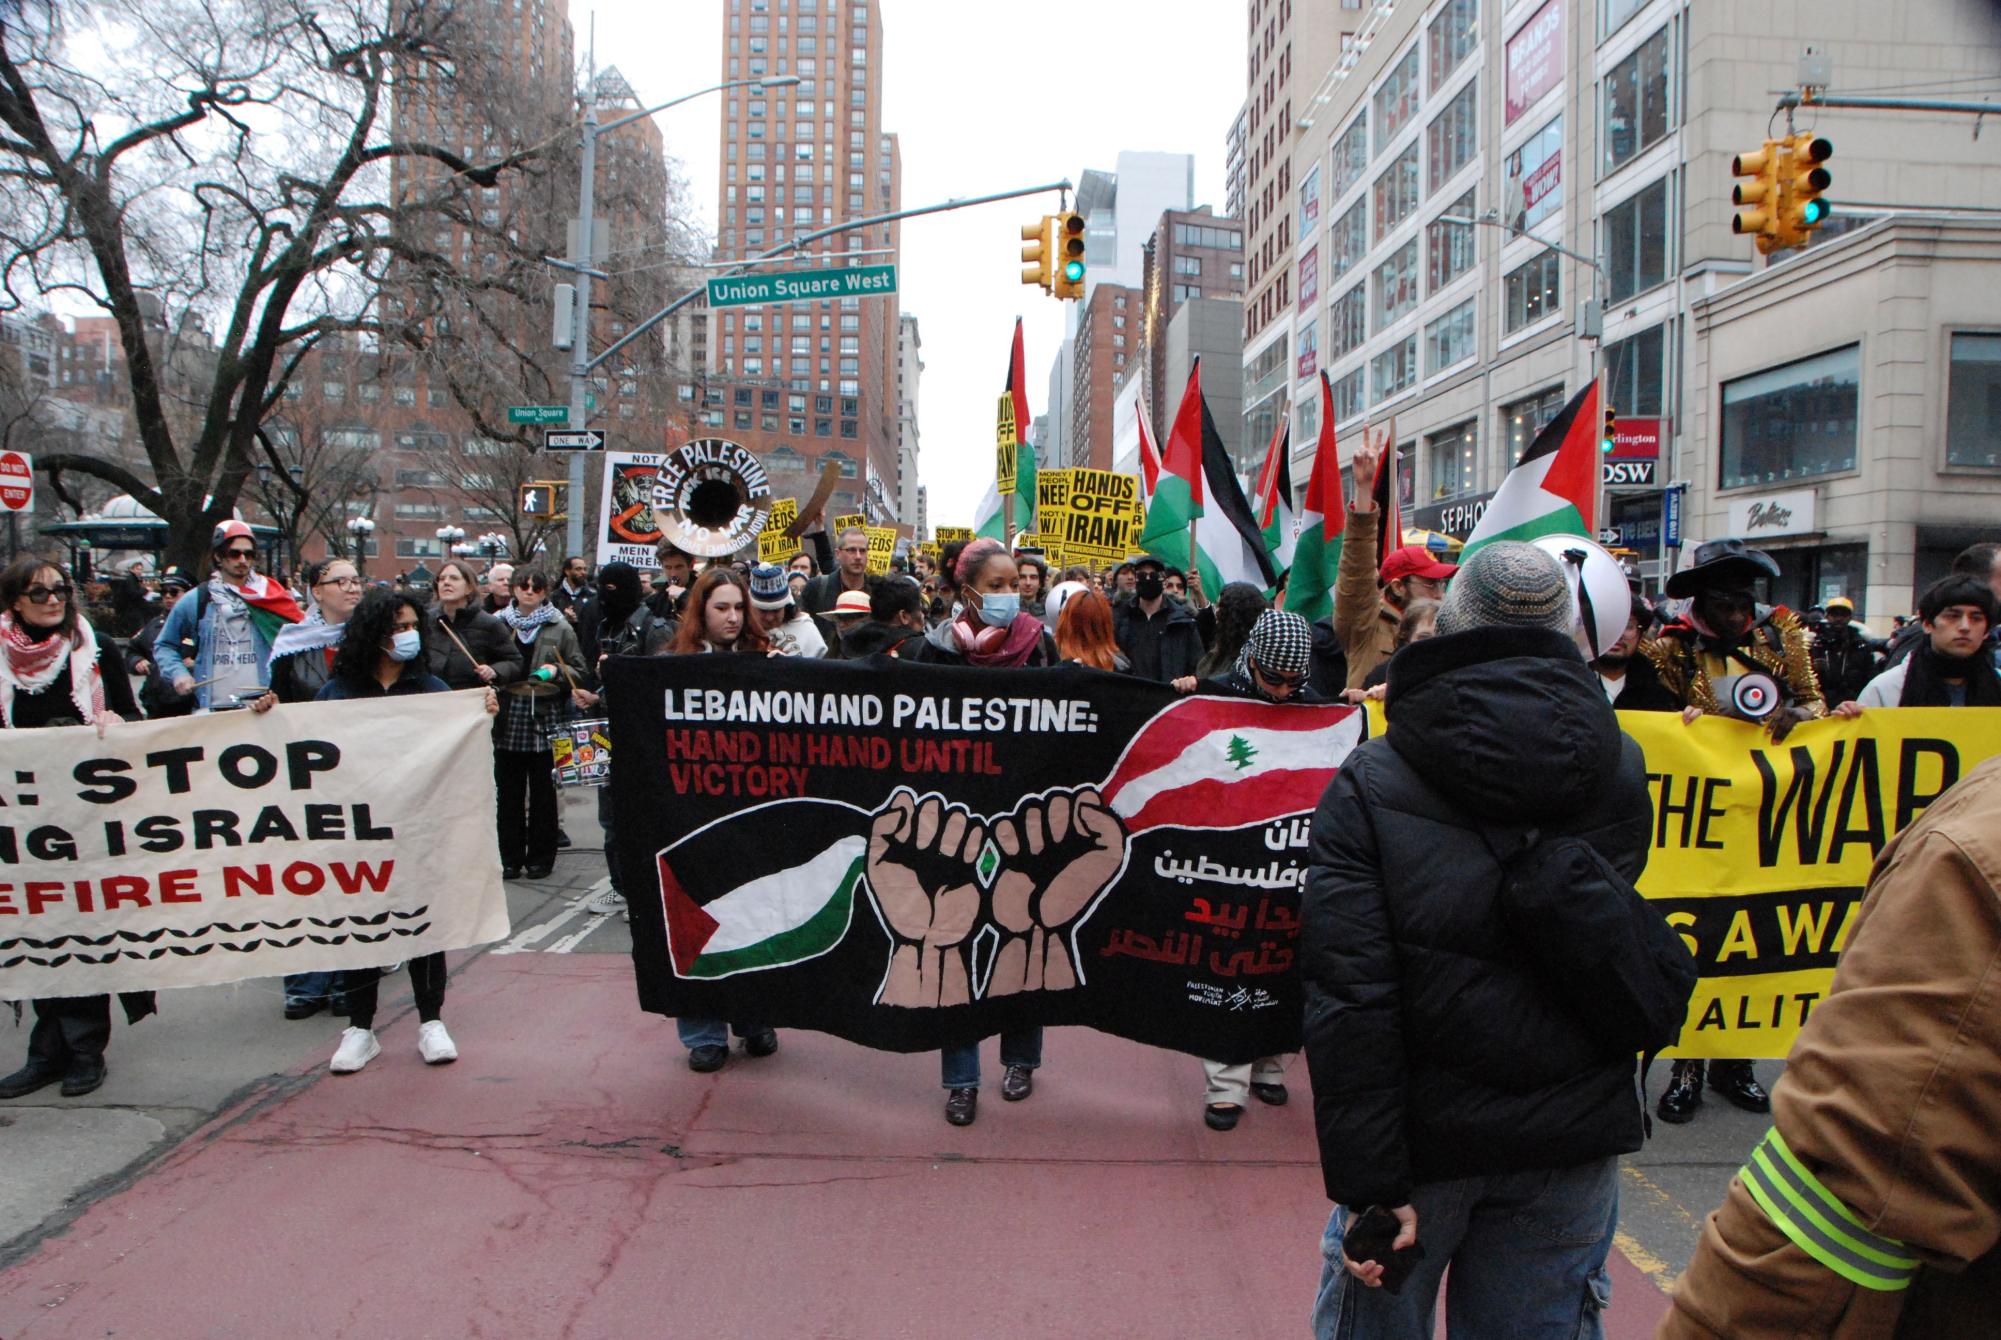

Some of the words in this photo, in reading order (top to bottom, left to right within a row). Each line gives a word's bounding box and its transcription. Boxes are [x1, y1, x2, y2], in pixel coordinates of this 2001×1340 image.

[714, 283, 769, 300] Union
[775, 278, 840, 298] Square
[845, 272, 890, 289] West
[514, 408, 536, 416] Union
[538, 408, 563, 418] Square
[554, 437, 569, 445] ONE
[578, 437, 596, 445] WAY
[632, 455, 659, 464] NOT
[652, 458, 686, 510] FREE
[680, 440, 771, 499] PALESTINE
[1073, 471, 1134, 499] HANDS
[1070, 494, 1131, 515] OFF
[1442, 500, 1492, 534] SEPHO
[677, 518, 710, 541] NO
[718, 503, 755, 538] WAR
[706, 533, 751, 556] EMBARGO
[748, 509, 769, 536] NOW!
[835, 518, 846, 528] NO
[847, 516, 864, 526] NEW
[936, 528, 956, 539] STOP
[958, 528, 971, 539] THE
[1040, 518, 1057, 533] W/
[1066, 513, 1128, 548] IRAN!
[619, 546, 649, 556] MEIN
[778, 538, 799, 552] IRAN
[213, 653, 257, 665] PARHEID
[664, 689, 815, 725] LEBANON
[820, 694, 884, 728] AND
[893, 695, 1099, 733] PALESTINE:
[666, 729, 761, 763] HAND
[769, 732, 801, 764] IN
[807, 735, 891, 770] HAND
[901, 738, 1003, 775] UNTIL
[73, 739, 341, 804] STOP
[669, 764, 809, 797] VICTORY
[1750, 738, 1960, 868] WAR
[106, 803, 394, 857] ISRAEL
[223, 859, 395, 897] NOW
[1101, 928, 1202, 965] النصر
[1715, 909, 1759, 963] A
